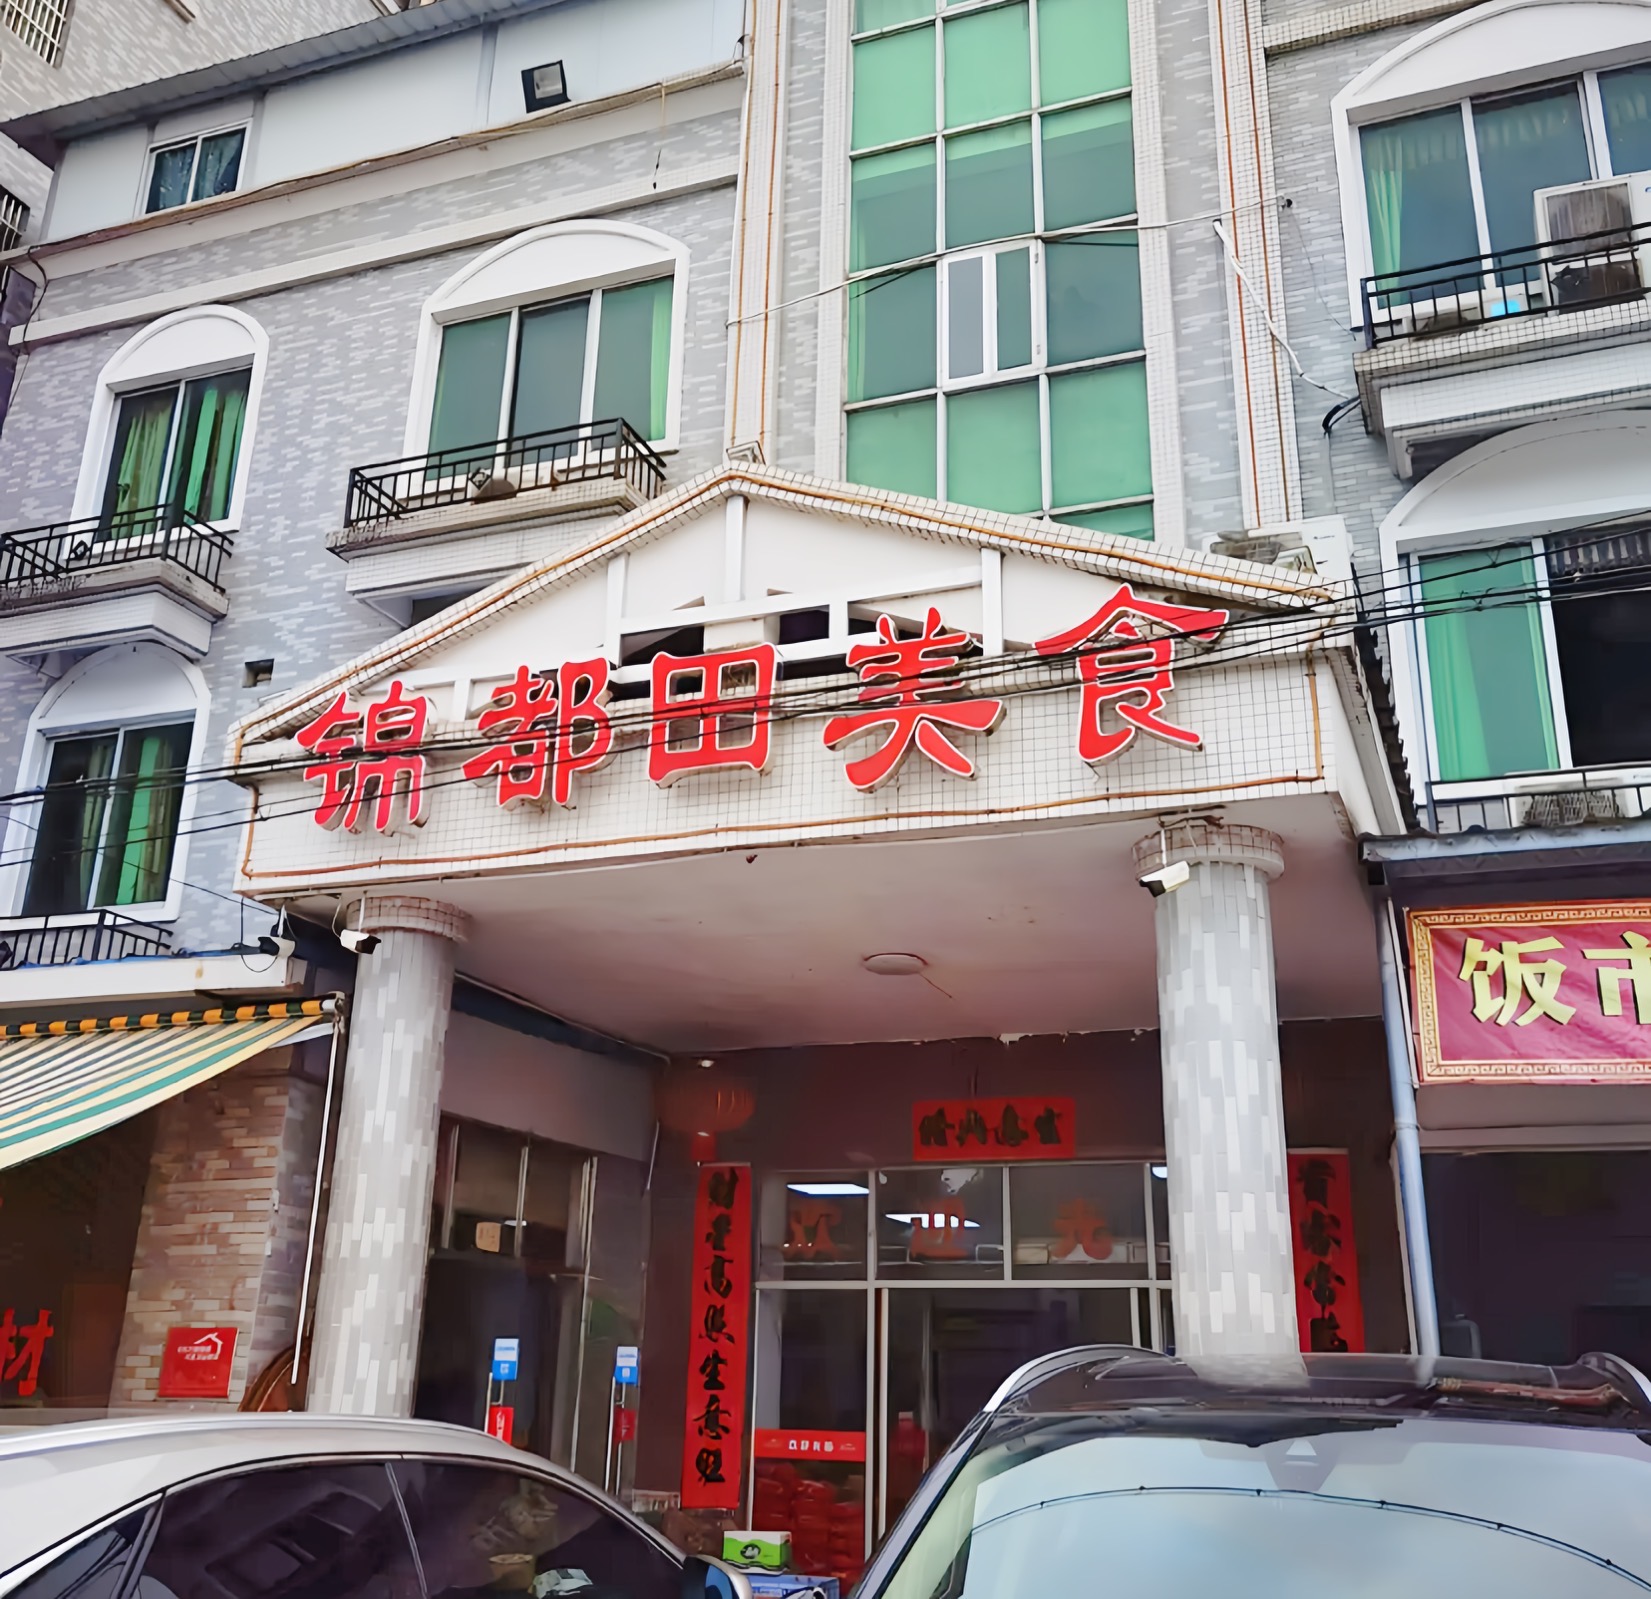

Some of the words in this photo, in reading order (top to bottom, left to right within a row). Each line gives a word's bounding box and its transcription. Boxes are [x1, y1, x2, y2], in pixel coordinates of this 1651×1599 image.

[294, 582, 1231, 833] 锦都田美食
